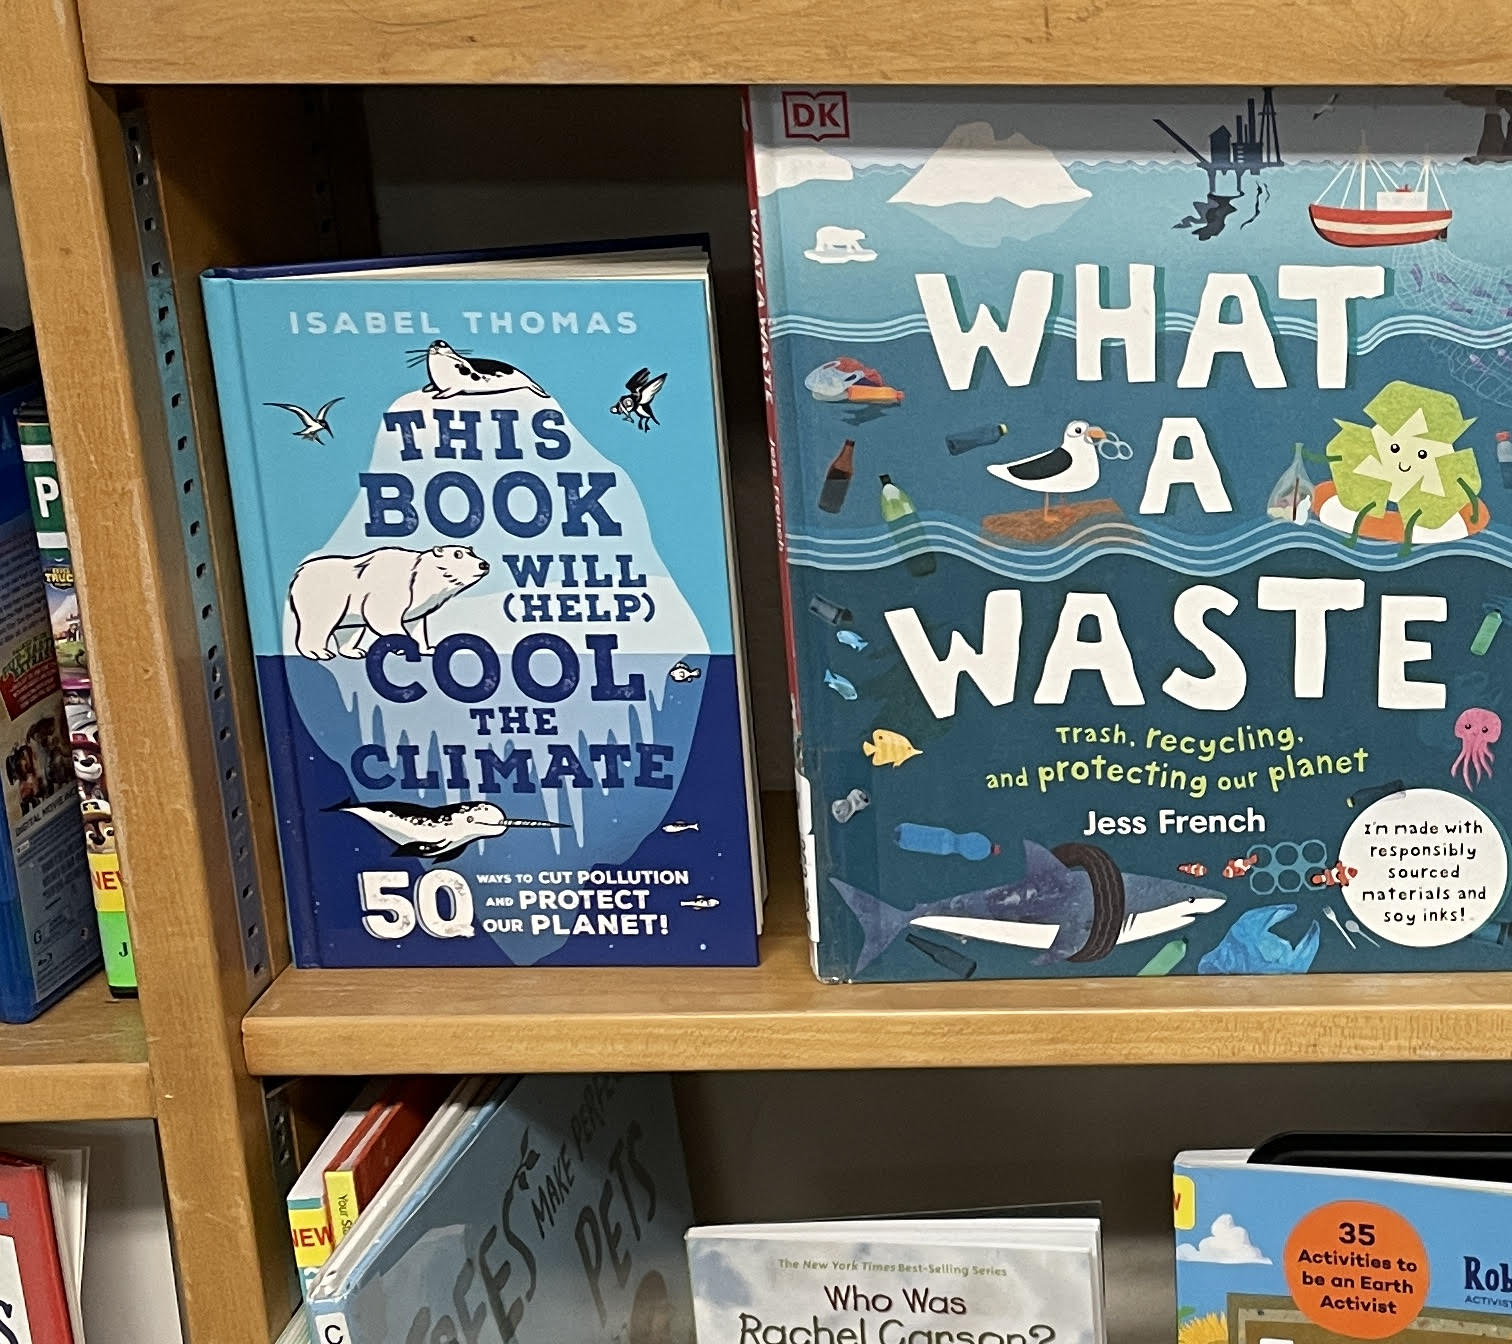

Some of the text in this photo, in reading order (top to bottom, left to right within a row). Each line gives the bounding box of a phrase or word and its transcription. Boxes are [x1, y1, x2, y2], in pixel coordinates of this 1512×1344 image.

[290, 311, 637, 335] ISABEL THOMAS
[915, 264, 1384, 391] WHAT
[884, 576, 1447, 719] WASTE
[366, 633, 646, 703] COOL
[470, 707, 558, 736] THE
[350, 744, 674, 793] CLIMATE
[1370, 843, 1477, 861] responsibly
[476, 871, 689, 885] WAYS TO CUT POLLUTION
[1388, 864, 1460, 880] sourced
[823, 1284, 967, 1315] Who Was
